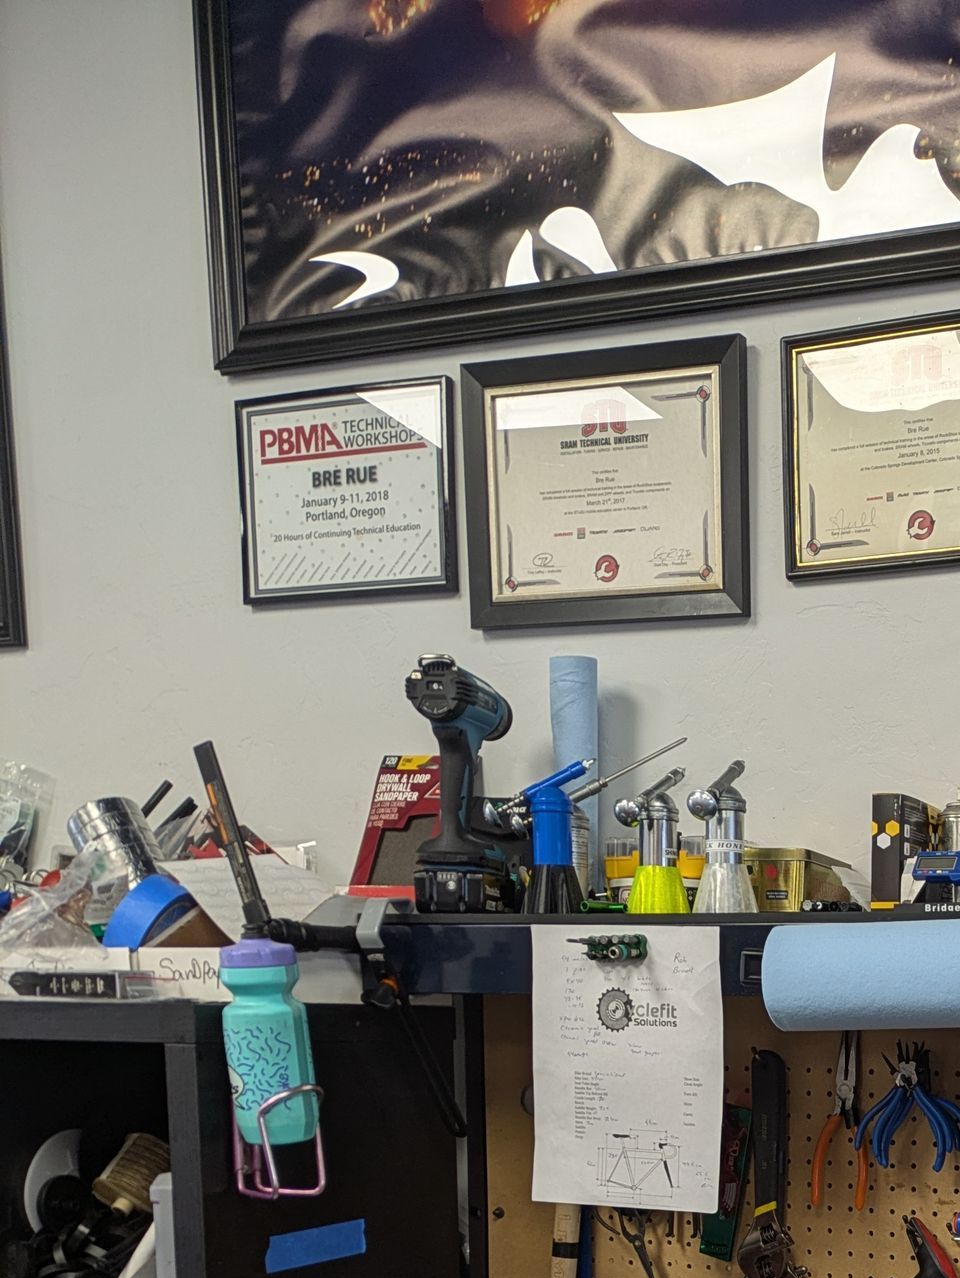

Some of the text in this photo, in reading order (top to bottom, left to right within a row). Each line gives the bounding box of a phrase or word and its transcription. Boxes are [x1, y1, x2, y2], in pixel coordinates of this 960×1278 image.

[259, 422, 344, 458] PBMA
[343, 427, 424, 449] WORKSHOPS
[560, 433, 649, 450] SRAM TECHNICAL UNIVERSITY
[898, 448, 941, 459] January 2015
[312, 465, 379, 488] BRE RUE
[300, 490, 390, 509] January 9-11, 2018
[305, 506, 386, 524] Portland, Oregon
[273, 522, 421, 543] 20 Hours of Continuing Technical Education
[379, 774, 400, 783] HOOK
[409, 774, 431, 783] LOOP
[377, 783, 411, 792] DRYWALL
[374, 792, 419, 801] SANDPAPER
[924, 903, 960, 912] Bridge
[634, 1018, 677, 1028] Solutions
